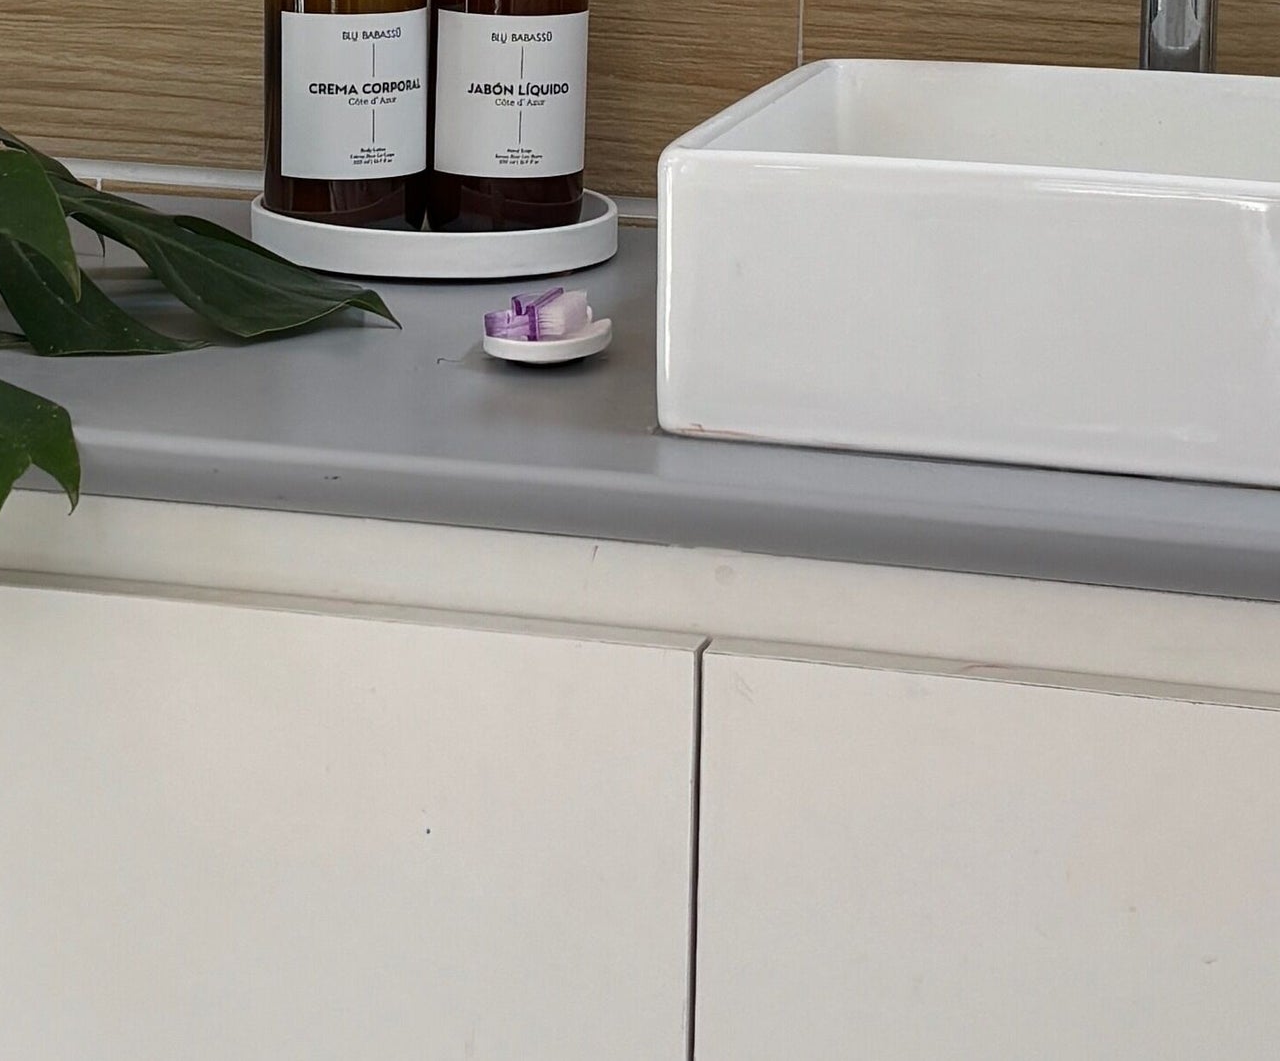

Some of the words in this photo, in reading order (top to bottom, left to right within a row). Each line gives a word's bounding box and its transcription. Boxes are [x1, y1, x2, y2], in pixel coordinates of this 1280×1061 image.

[308, 83, 358, 95] CREMA
[362, 78, 421, 94] CORPORAL
[467, 82, 514, 95] JABÓN
[518, 82, 569, 97] LÍQUIDO
